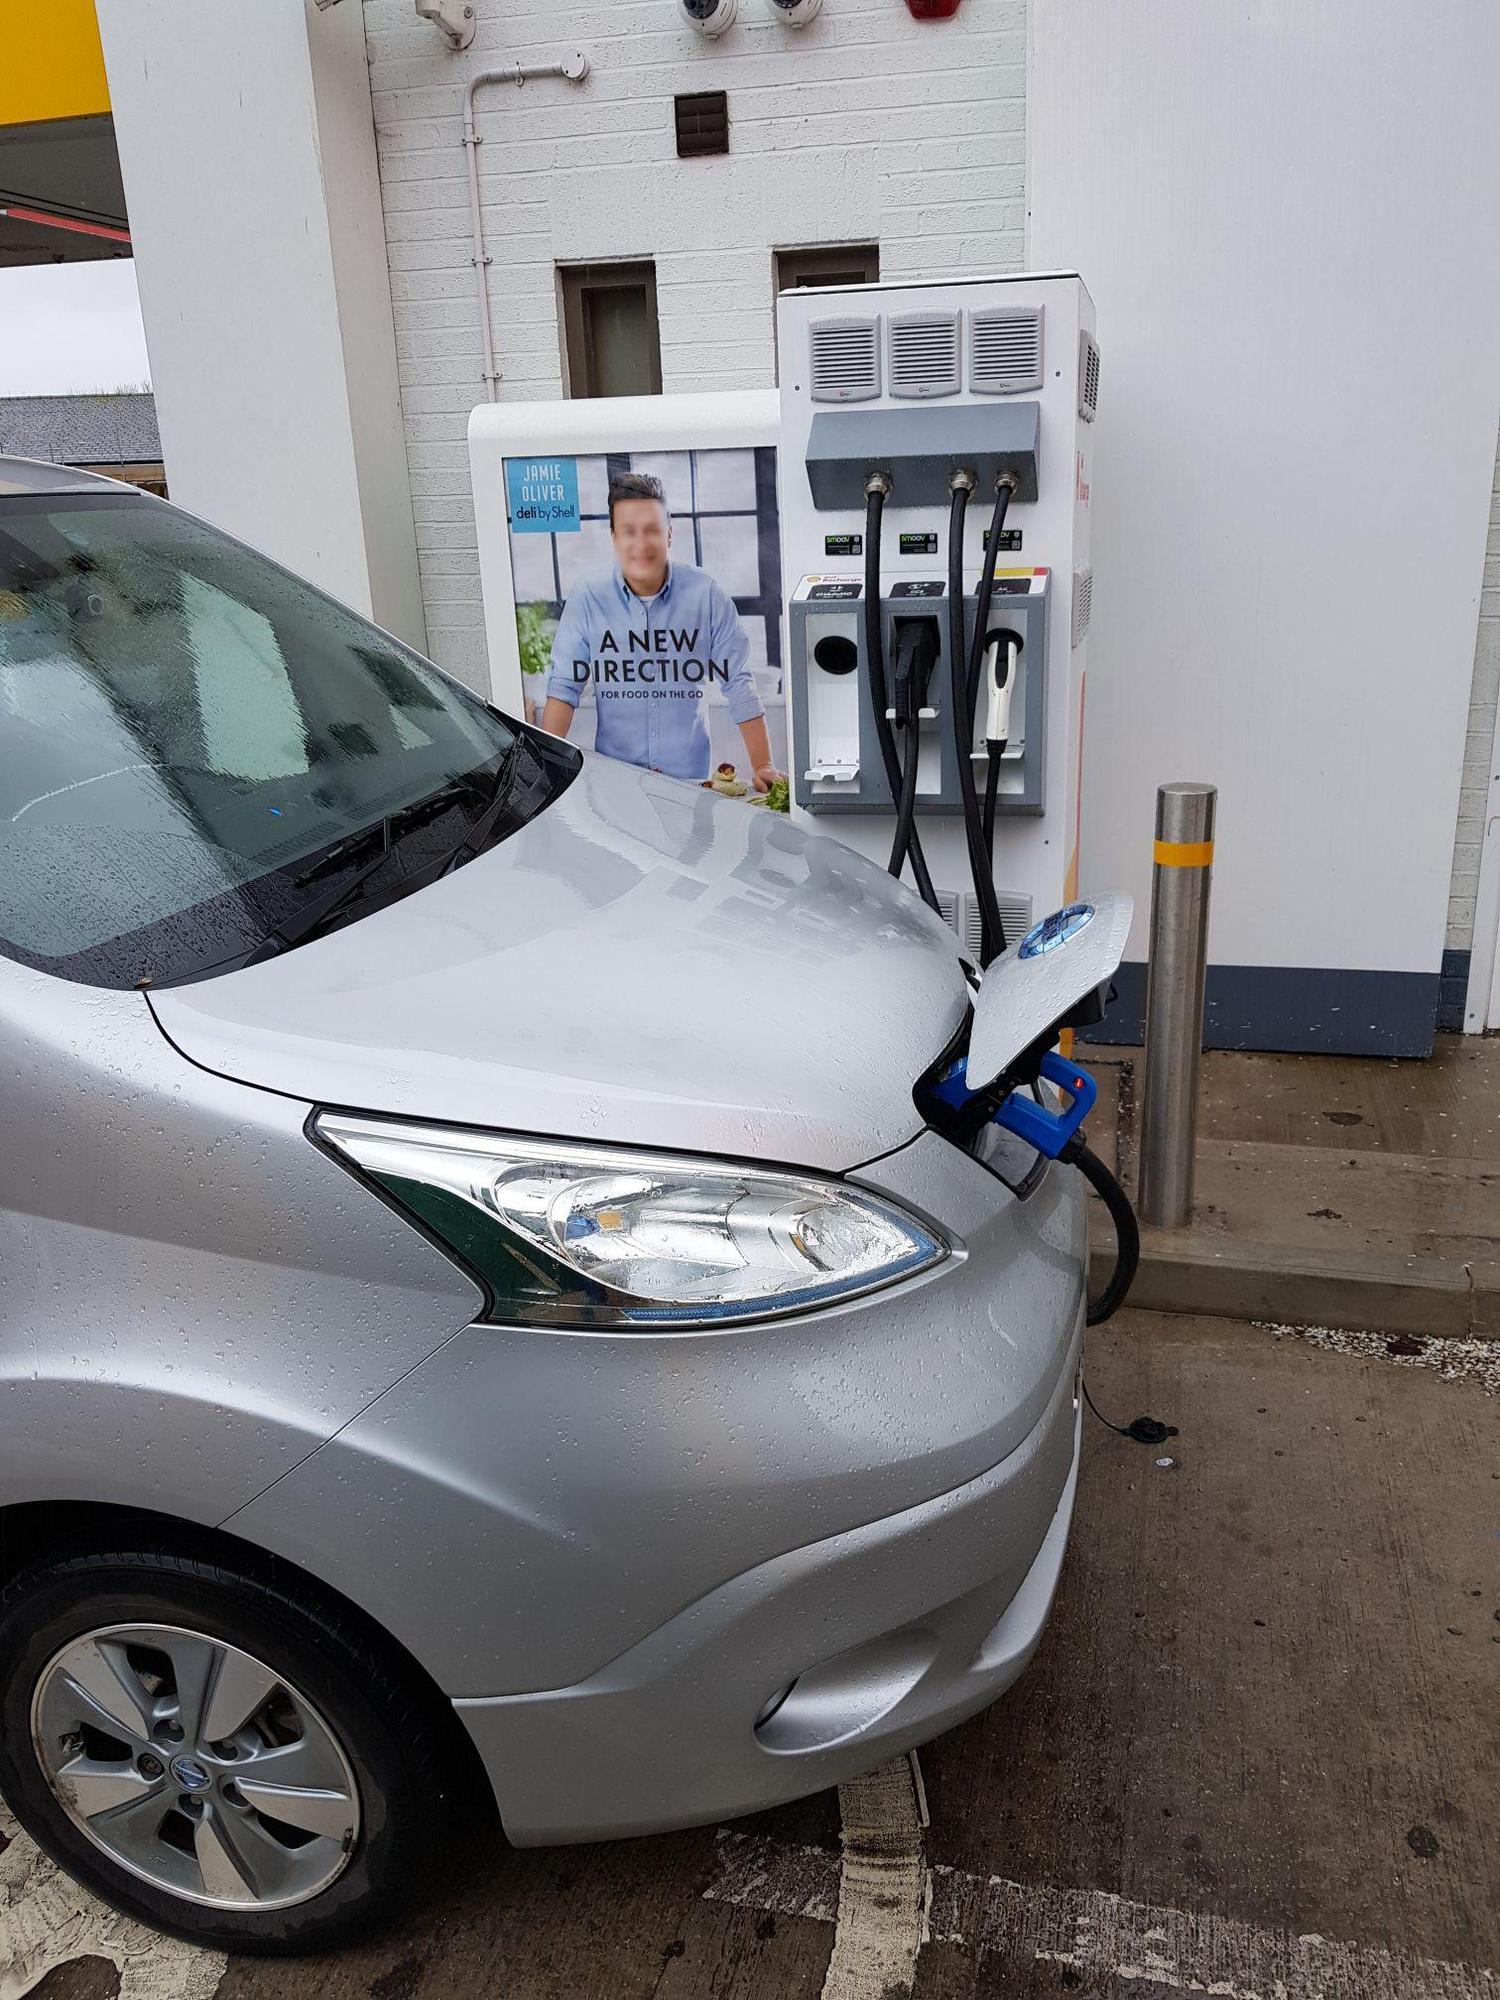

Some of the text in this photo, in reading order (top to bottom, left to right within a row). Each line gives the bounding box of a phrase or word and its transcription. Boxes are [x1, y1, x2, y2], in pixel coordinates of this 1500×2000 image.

[523, 464, 561, 481] JAMIE
[522, 484, 565, 502] OLIVER
[516, 504, 575, 521] deli by Shell
[599, 628, 700, 653] A NEW
[572, 658, 730, 683] DIRECTION
[601, 690, 704, 699] FOR FOOD ON THE GO
